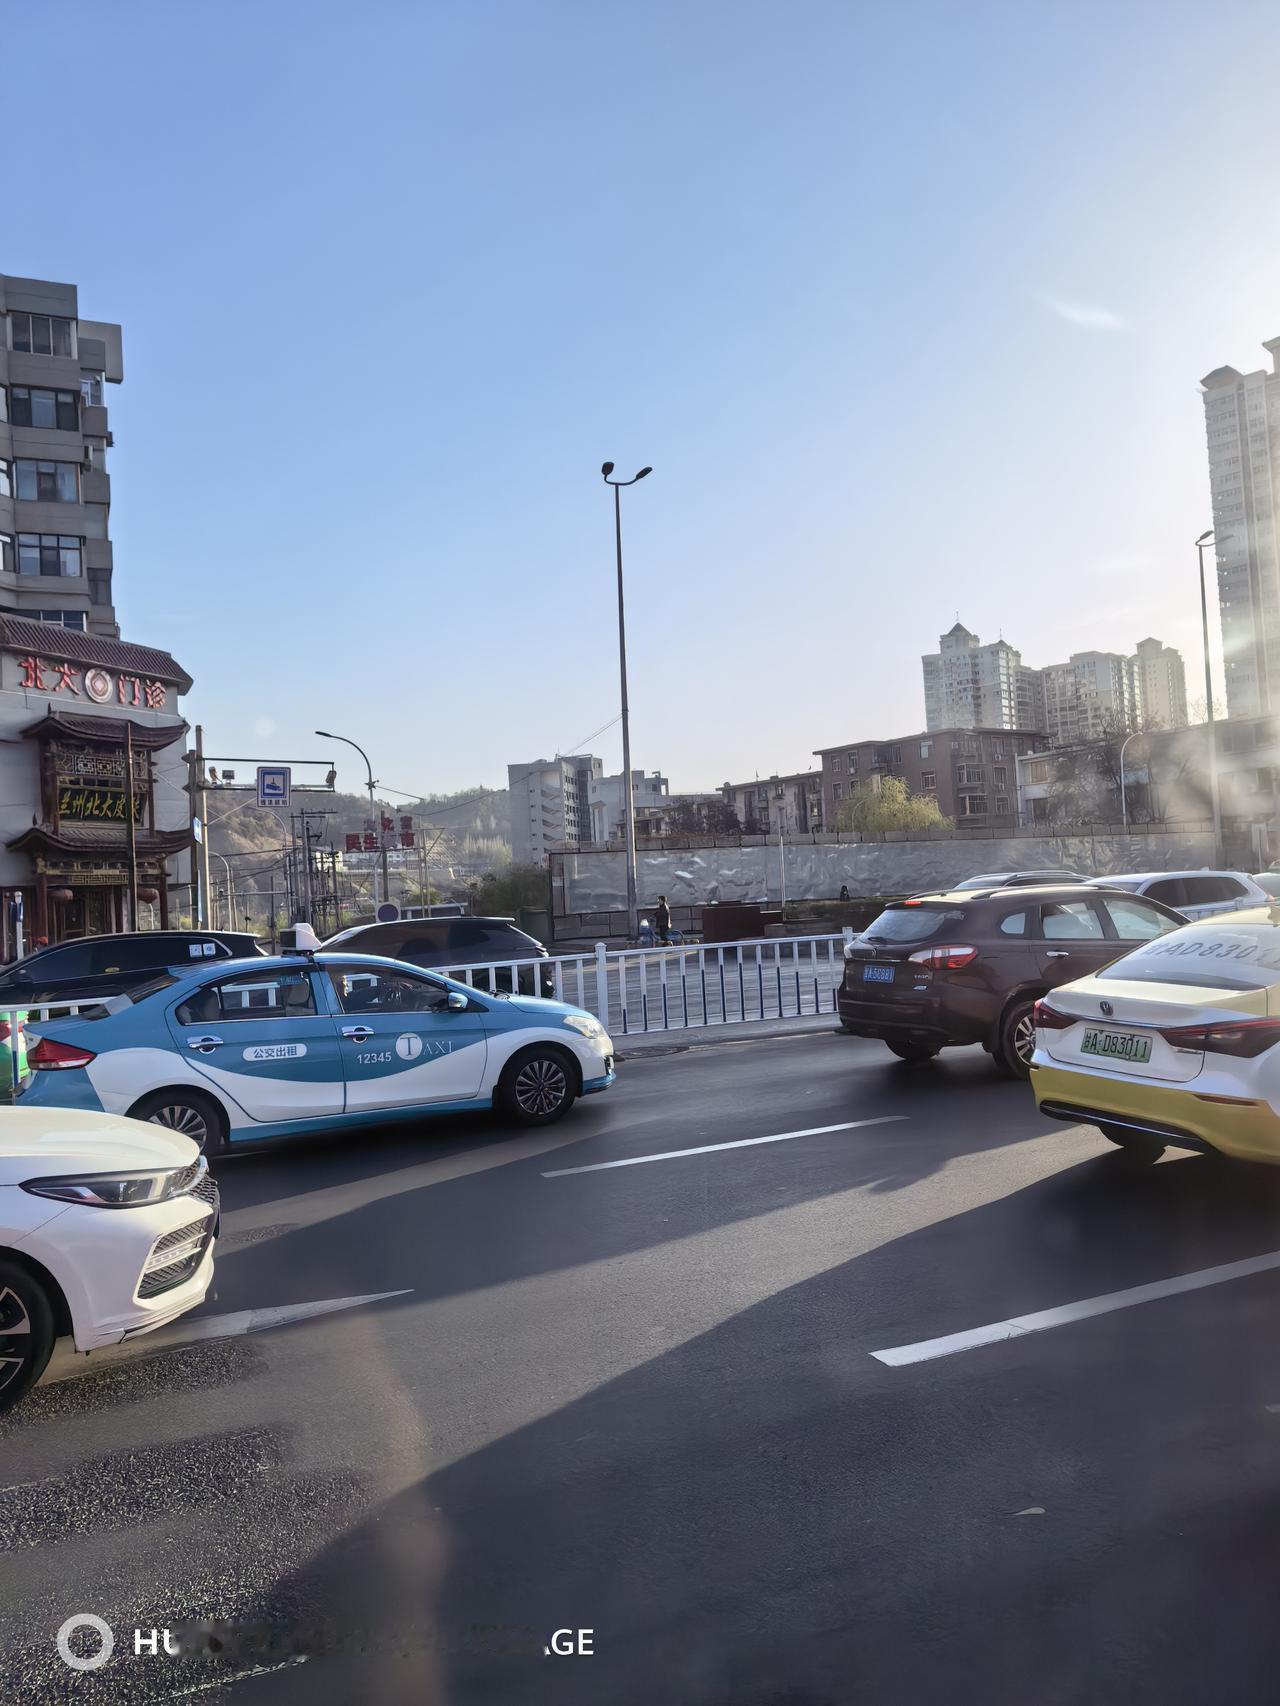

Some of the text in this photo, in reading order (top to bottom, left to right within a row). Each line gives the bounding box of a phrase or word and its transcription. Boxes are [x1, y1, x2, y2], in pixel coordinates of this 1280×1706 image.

[253, 1045, 298, 1059] 公交出租
[356, 1051, 393, 1065] 12345
